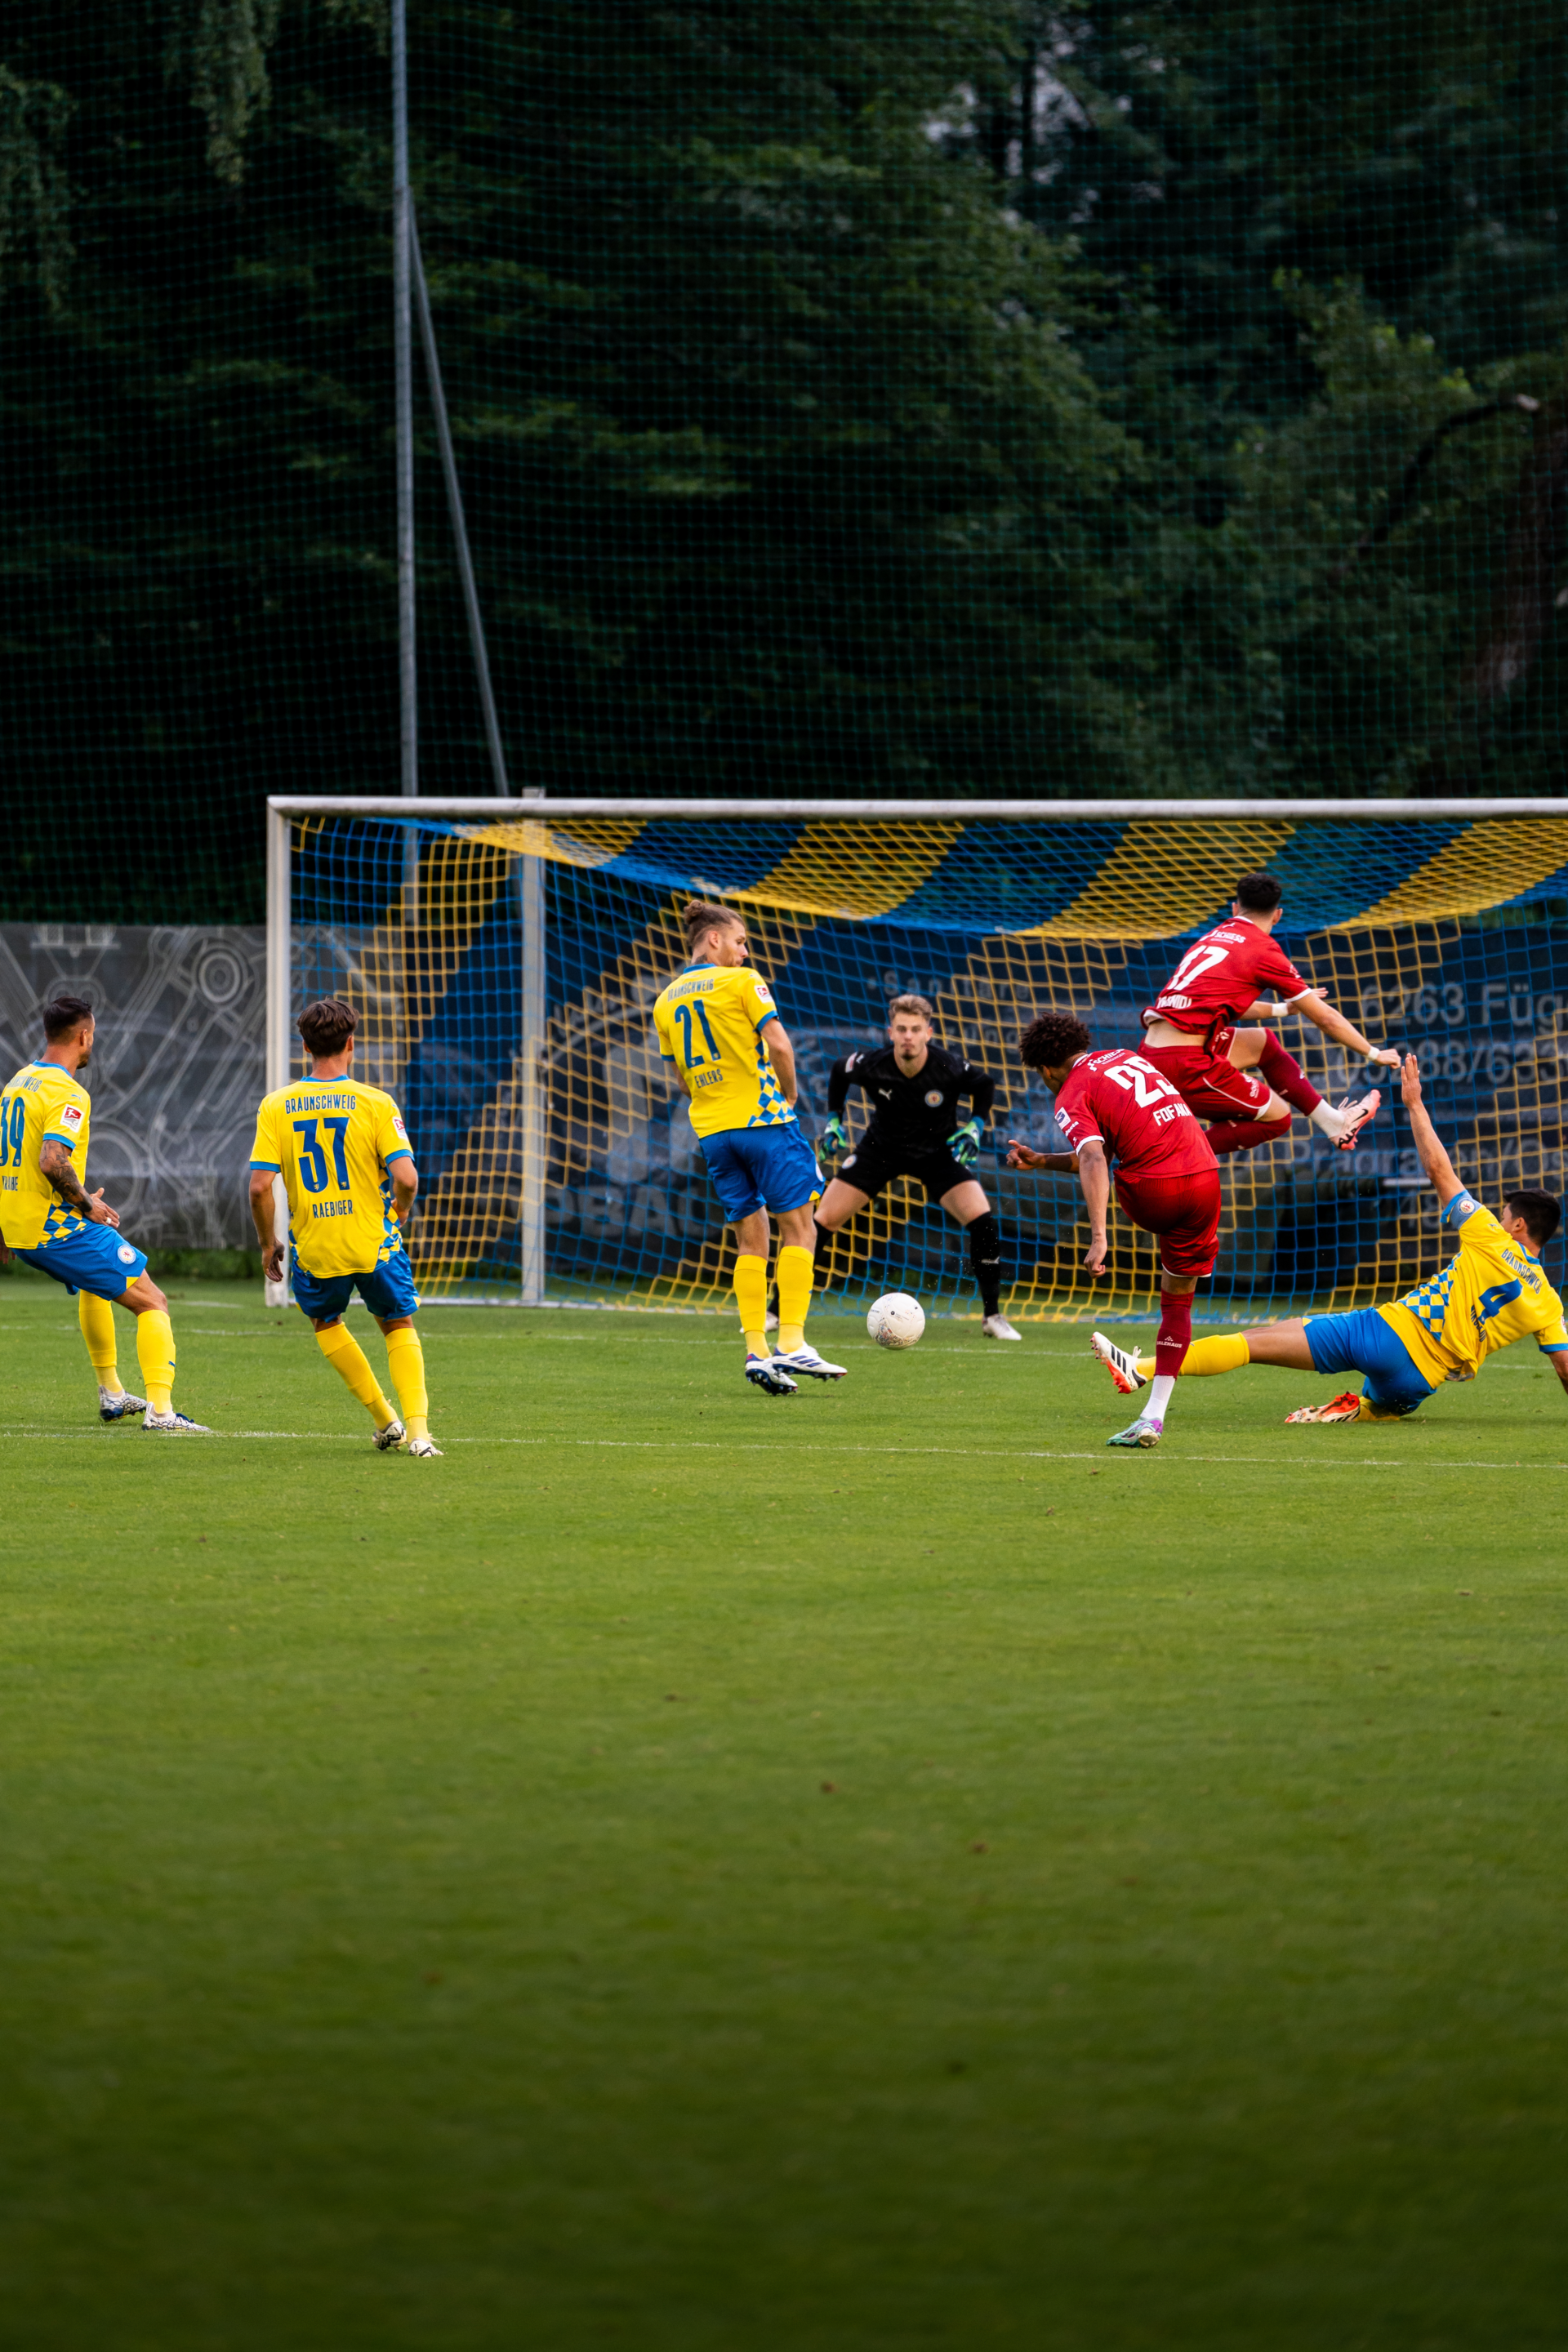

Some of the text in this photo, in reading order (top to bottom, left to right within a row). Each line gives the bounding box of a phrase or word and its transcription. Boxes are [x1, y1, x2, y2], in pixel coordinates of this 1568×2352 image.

[1167, 945, 1230, 991] 17
[1481, 982, 1568, 1036] Füg
[675, 1000, 722, 1069] 21
[694, 1069, 724, 1089] EHLERS
[1104, 1056, 1181, 1108] 29
[285, 1094, 356, 1114] BRAUNSCHWEIG
[1153, 1102, 1193, 1126] FOFANA
[292, 1117, 350, 1193] 37
[312, 1199, 354, 1218] RAEBIGER
[1477, 1277, 1524, 1325] 4
